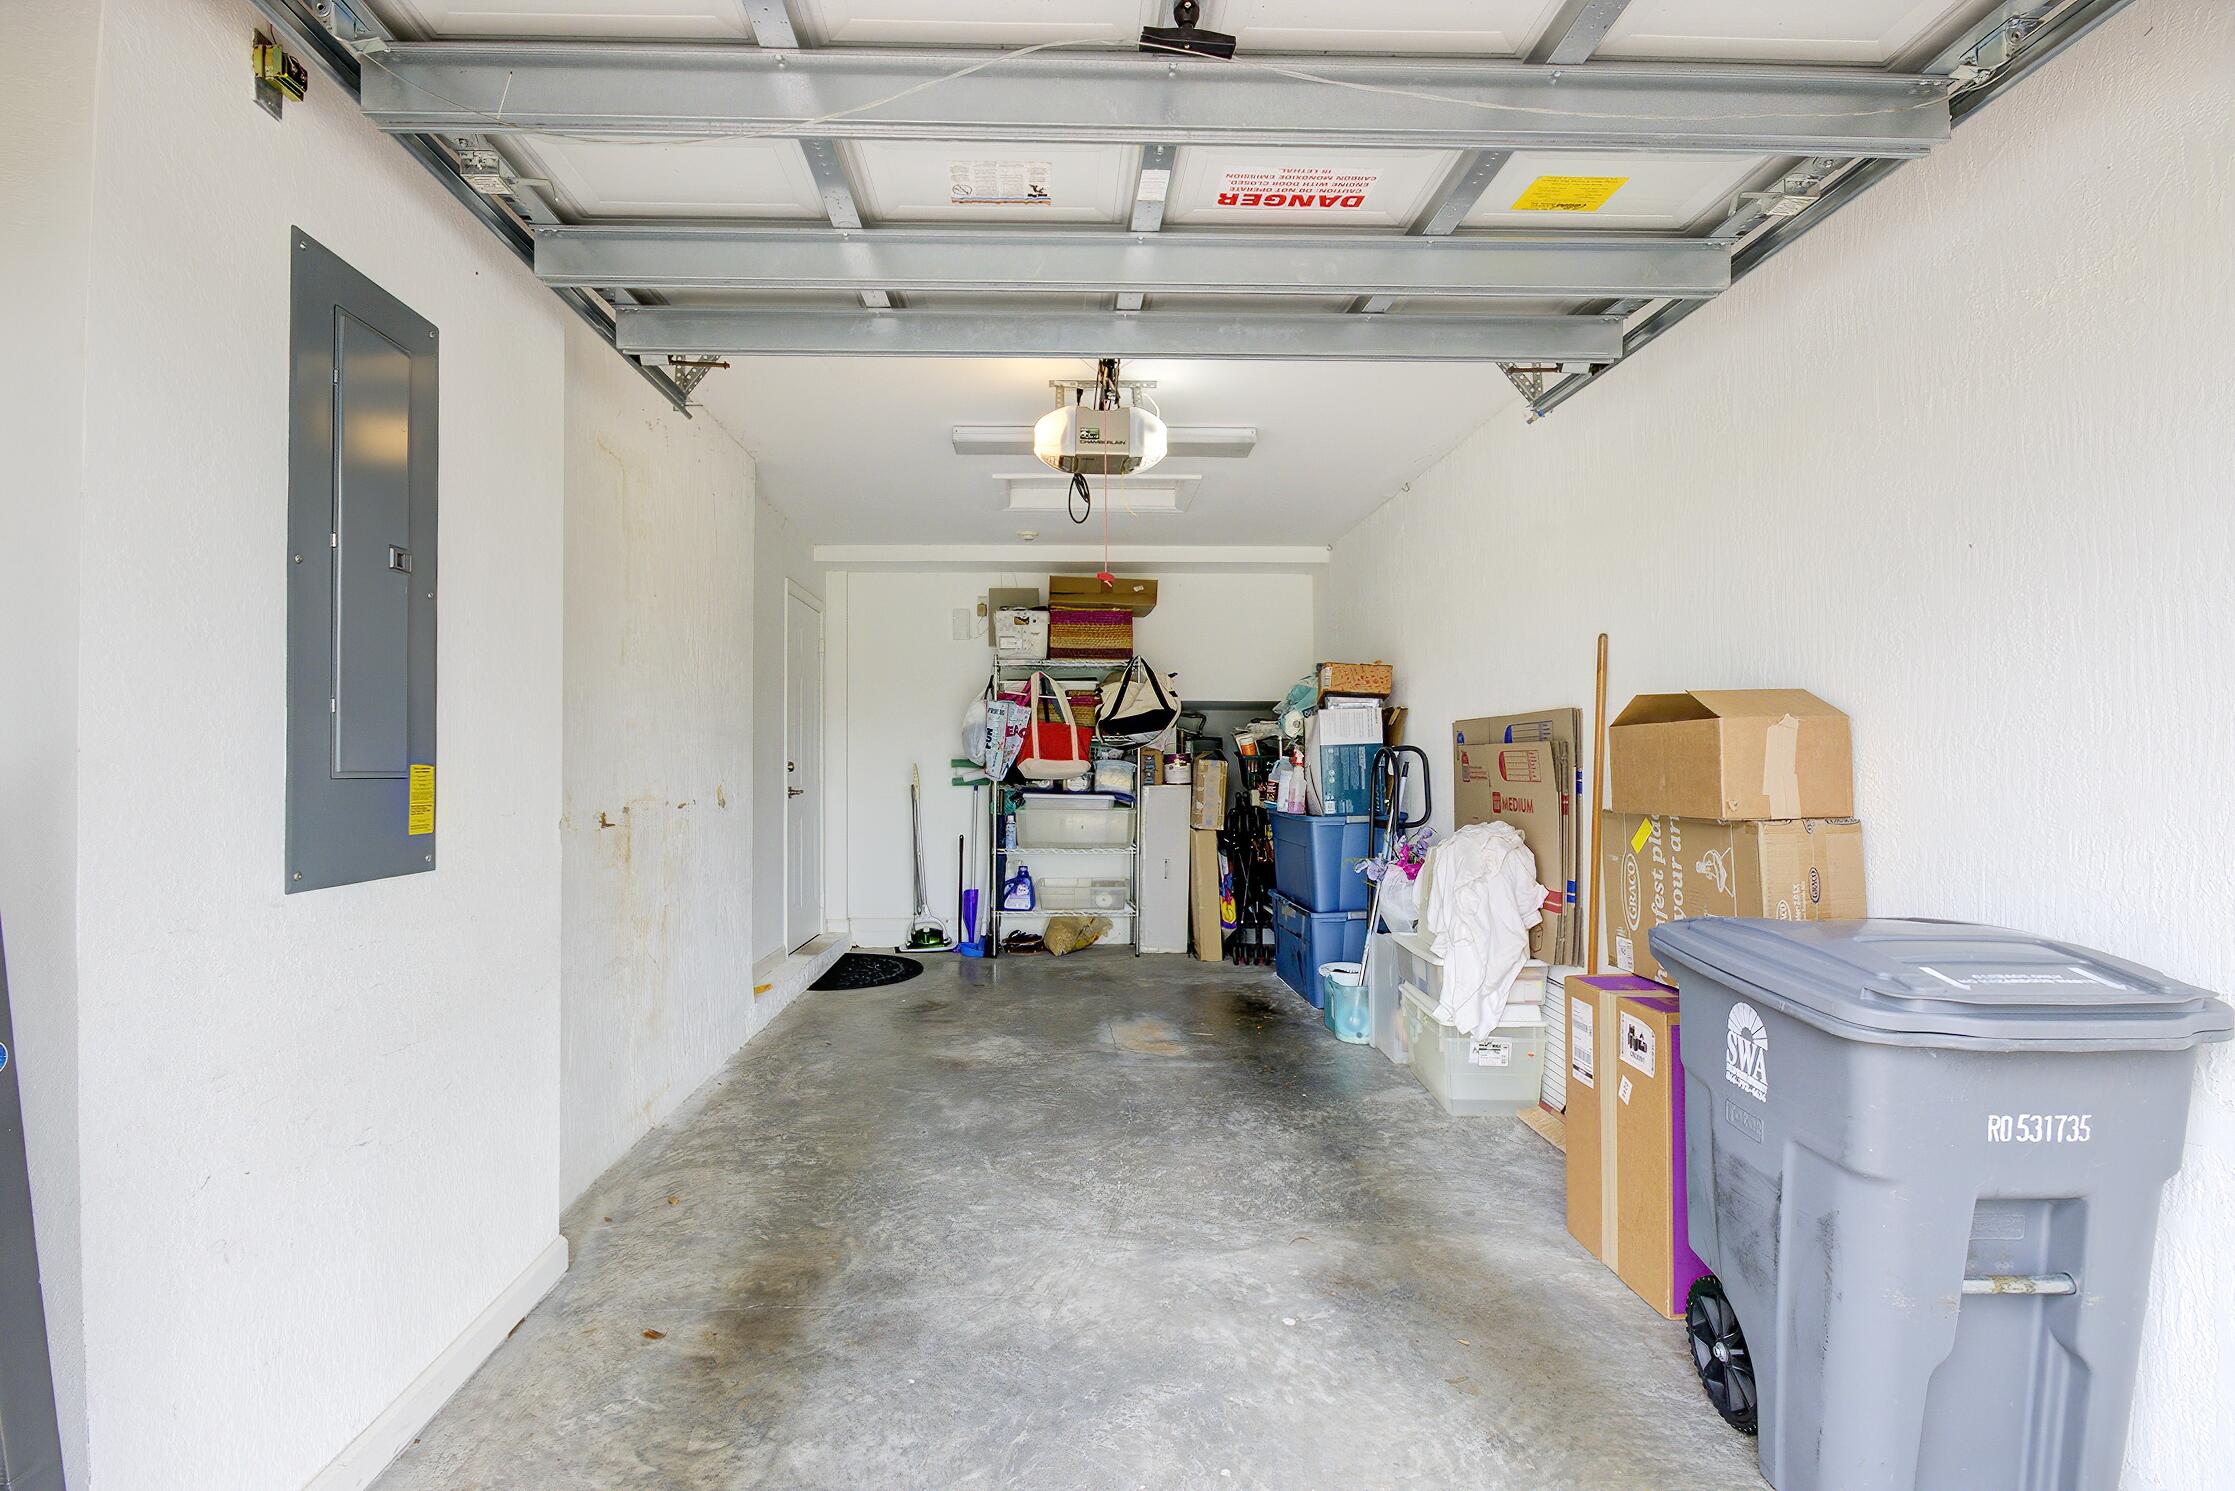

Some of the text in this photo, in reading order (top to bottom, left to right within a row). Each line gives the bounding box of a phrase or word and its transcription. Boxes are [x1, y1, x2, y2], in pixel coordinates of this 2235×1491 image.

[1217, 193, 1365, 208] DANGER
[1501, 796, 1534, 814] MEDIUM
[1627, 862, 1639, 920] GRACO
[1651, 868, 1668, 927] fest
[1671, 857, 1687, 920] your
[1726, 1030, 1769, 1086] SWA
[2016, 1114, 2093, 1143] 531735
